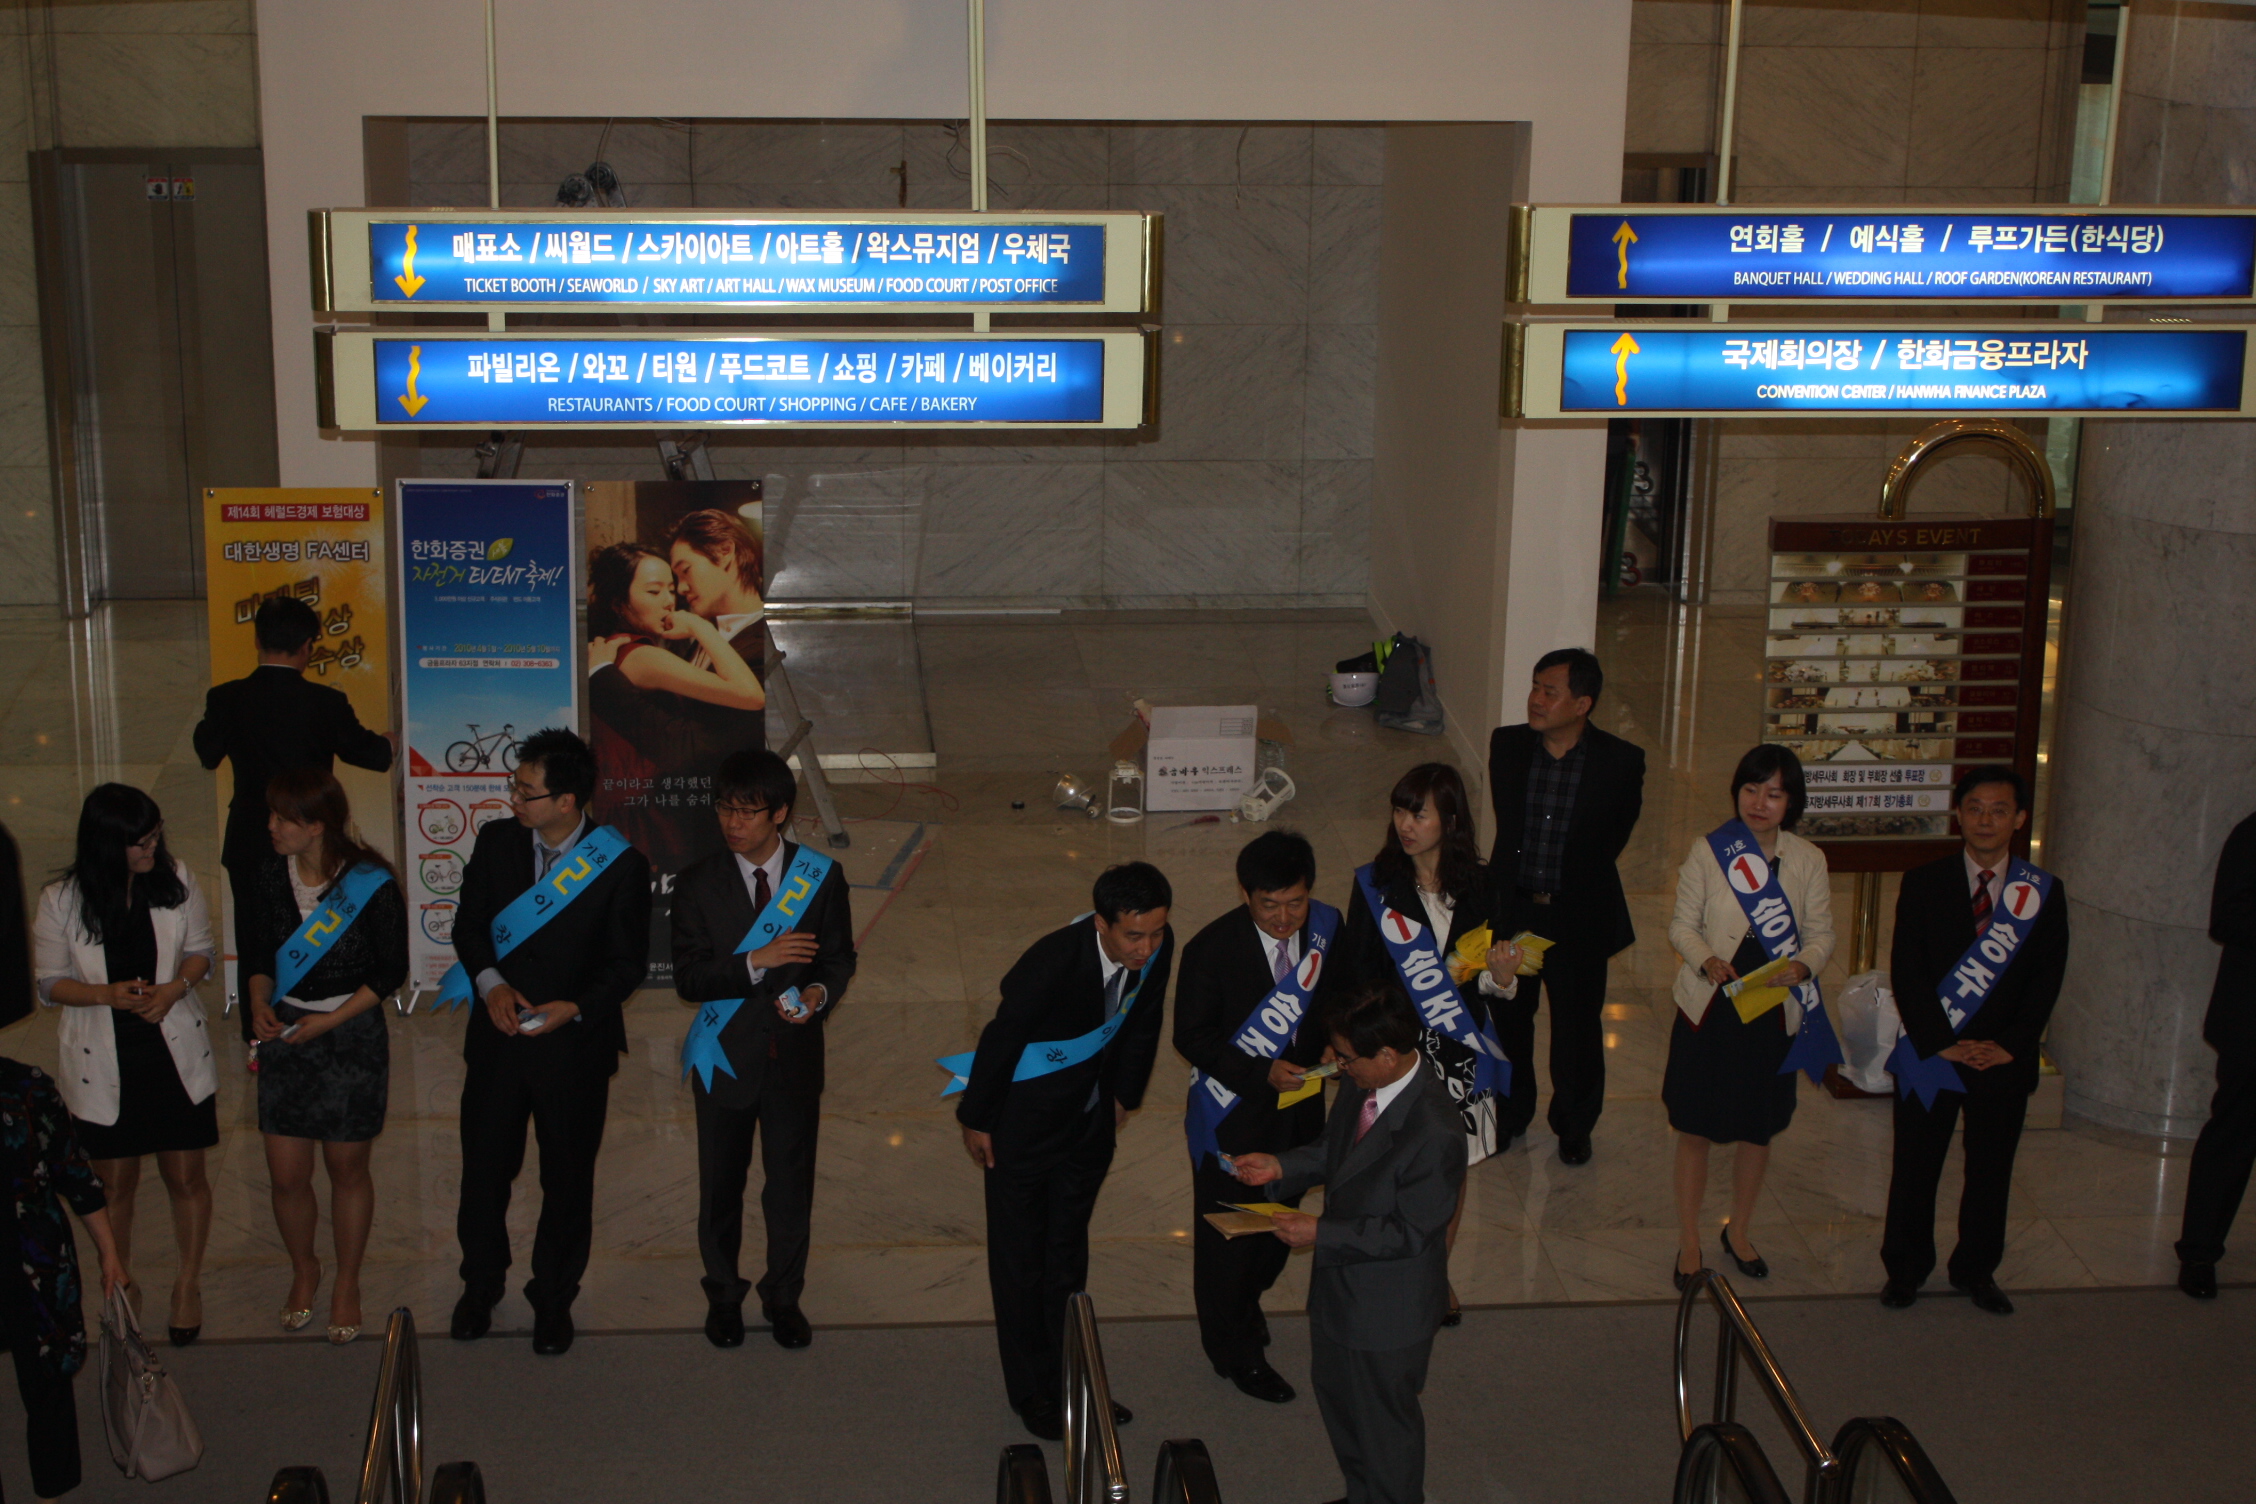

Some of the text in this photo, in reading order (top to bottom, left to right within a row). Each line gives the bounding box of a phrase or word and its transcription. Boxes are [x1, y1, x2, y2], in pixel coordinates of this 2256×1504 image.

[452, 231, 522, 265] 매표소
[544, 231, 616, 265] 씨월드
[637, 231, 753, 265] 스카이아트
[776, 231, 844, 265] 아트홀
[867, 231, 980, 265] 왁스뮤지엄
[1003, 231, 1071, 265] 우체국
[1730, 225, 1804, 253] 연회홀
[1850, 225, 1924, 253] 예식홀
[1968, 225, 2164, 253] 루프가든(한식당)
[464, 278, 508, 293] TICKET
[511, 278, 555, 293] BOOTH
[567, 278, 638, 293] SEAWORLD
[653, 278, 676, 293] SKY
[680, 278, 703, 293] ART
[716, 278, 739, 293] ART
[743, 278, 775, 293] HALL
[786, 278, 816, 293] WAX
[818, 278, 875, 293] MUSEUM
[887, 278, 923, 293] FOOD
[926, 278, 969, 293] COURT
[980, 278, 1012, 293] POST
[1015, 278, 1058, 293] OFFICE
[1734, 272, 1791, 286] BANQUET
[1794, 272, 1824, 286] HALL
[1834, 272, 1891, 286] WEDDING
[1894, 272, 1924, 286] HALL
[1935, 272, 1967, 286] ROOF
[1970, 272, 2071, 286] GARDEN(KOREAN
[2074, 272, 2152, 286] RESTAURANT)
[1721, 339, 1863, 371] 국제회의장
[1897, 339, 2088, 371] 한화금융프라자
[467, 352, 560, 383] 파빌리온
[583, 352, 629, 383] 와꼬
[653, 352, 698, 383] 티원
[719, 352, 812, 383] 푸드코트
[833, 352, 877, 383] 쇼핑
[901, 352, 946, 383] 카페
[968, 352, 1057, 383] 베이커리
[1757, 384, 1839, 399] CONVENTION
[1841, 384, 1885, 399] CENTER
[1896, 384, 1951, 399] HANWHA
[1954, 384, 2006, 399] FINANCE
[2009, 384, 2046, 399] PLAZA
[548, 397, 652, 411] RESTAURANTS
[667, 397, 711, 411] FOOD
[714, 397, 766, 411] COURT
[780, 397, 856, 411] SHOPPING
[870, 397, 907, 411] CAFE
[922, 397, 977, 411] BAKERY
[227, 504, 364, 519] 제14회 헤럴드경제 보험대상
[1916, 528, 1982, 545] EVENT
[224, 541, 369, 562] 대한생명 FA센터
[411, 540, 485, 561] 한화증권
[412, 559, 565, 592] 자전거 EVENT 축제!
[308, 635, 365, 675] 수상
[602, 776, 712, 790] 끝이라고 생각했던
[1842, 770, 1856, 783] 회장
[1858, 770, 1865, 783] 및
[1867, 769, 1888, 782] 부회장
[1889, 769, 1903, 782] 선출
[1905, 769, 1925, 782] 투표장
[624, 793, 712, 807] 그가 나를 숨쉬
[1856, 795, 1881, 808] 제17회
[1884, 795, 1914, 808] 정기총회
[582, 841, 608, 868] 기호
[1724, 839, 1747, 857] 기호
[552, 856, 592, 895] 2
[796, 860, 823, 882] 기호
[1733, 856, 1760, 891] 1
[2019, 868, 2041, 886] 기호
[776, 875, 811, 916] 2
[2012, 884, 2031, 917] 1
[303, 909, 343, 947] 2
[1386, 909, 1413, 942] 1
[1311, 932, 1327, 951] 기호
